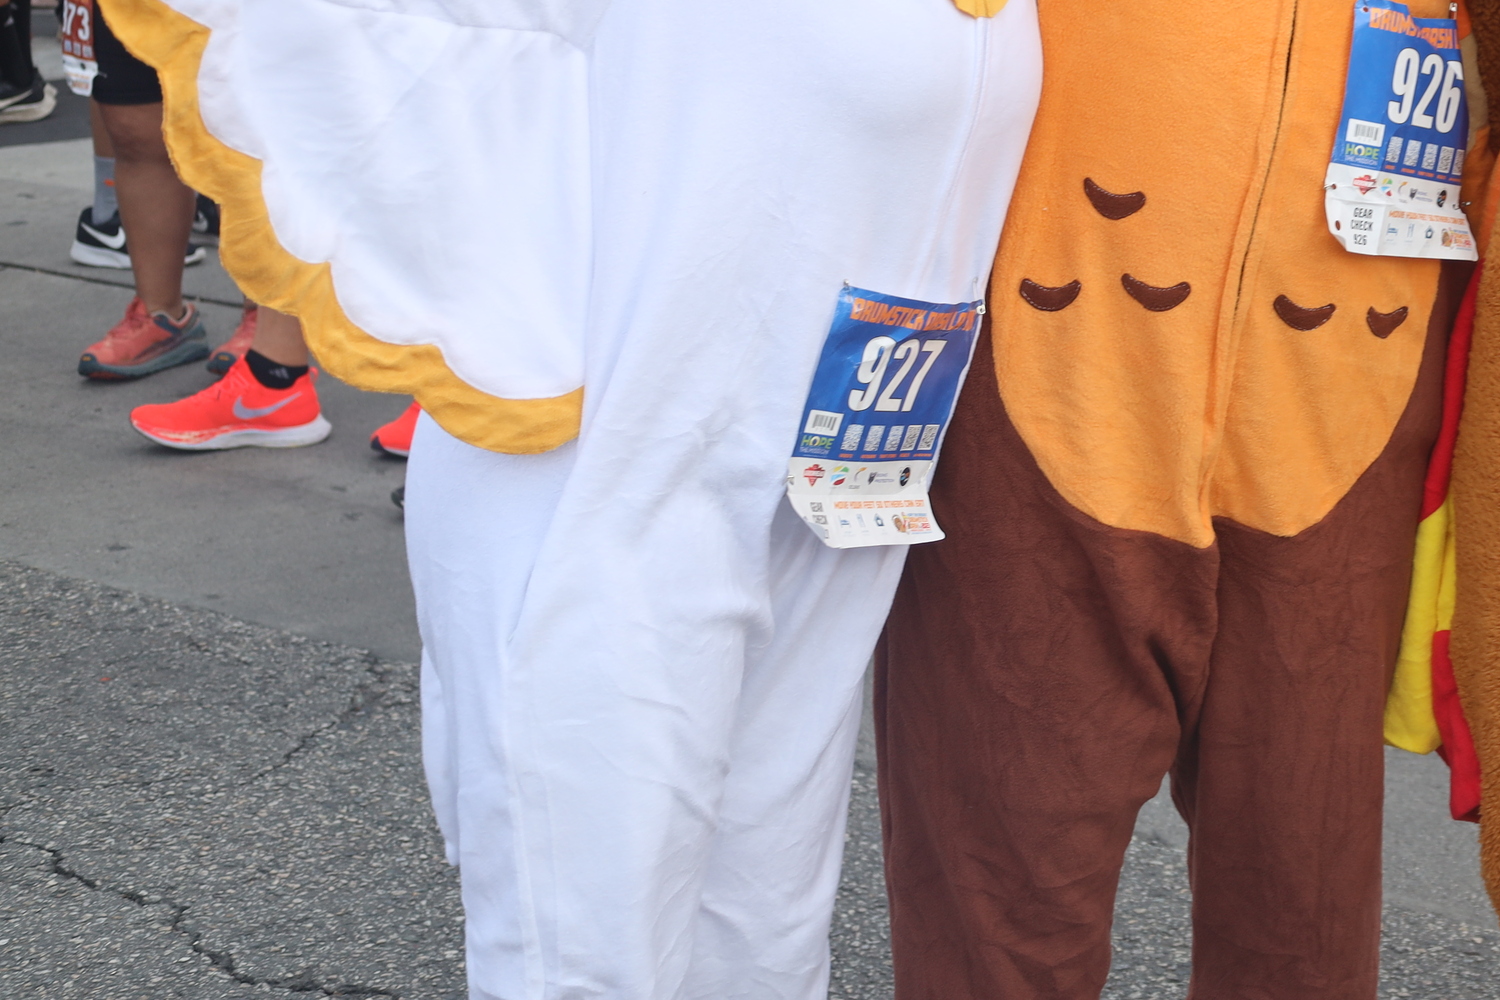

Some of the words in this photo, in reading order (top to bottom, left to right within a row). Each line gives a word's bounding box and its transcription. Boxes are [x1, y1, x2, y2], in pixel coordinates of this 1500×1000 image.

[1387, 47, 1465, 134] 926
[1345, 143, 1380, 160] HOPE
[1353, 207, 1373, 219] GEAR
[1350, 219, 1373, 231] CHECK
[851, 298, 926, 331] DRUMSTICK
[847, 335, 948, 412] 927
[801, 435, 835, 449] HOPE
